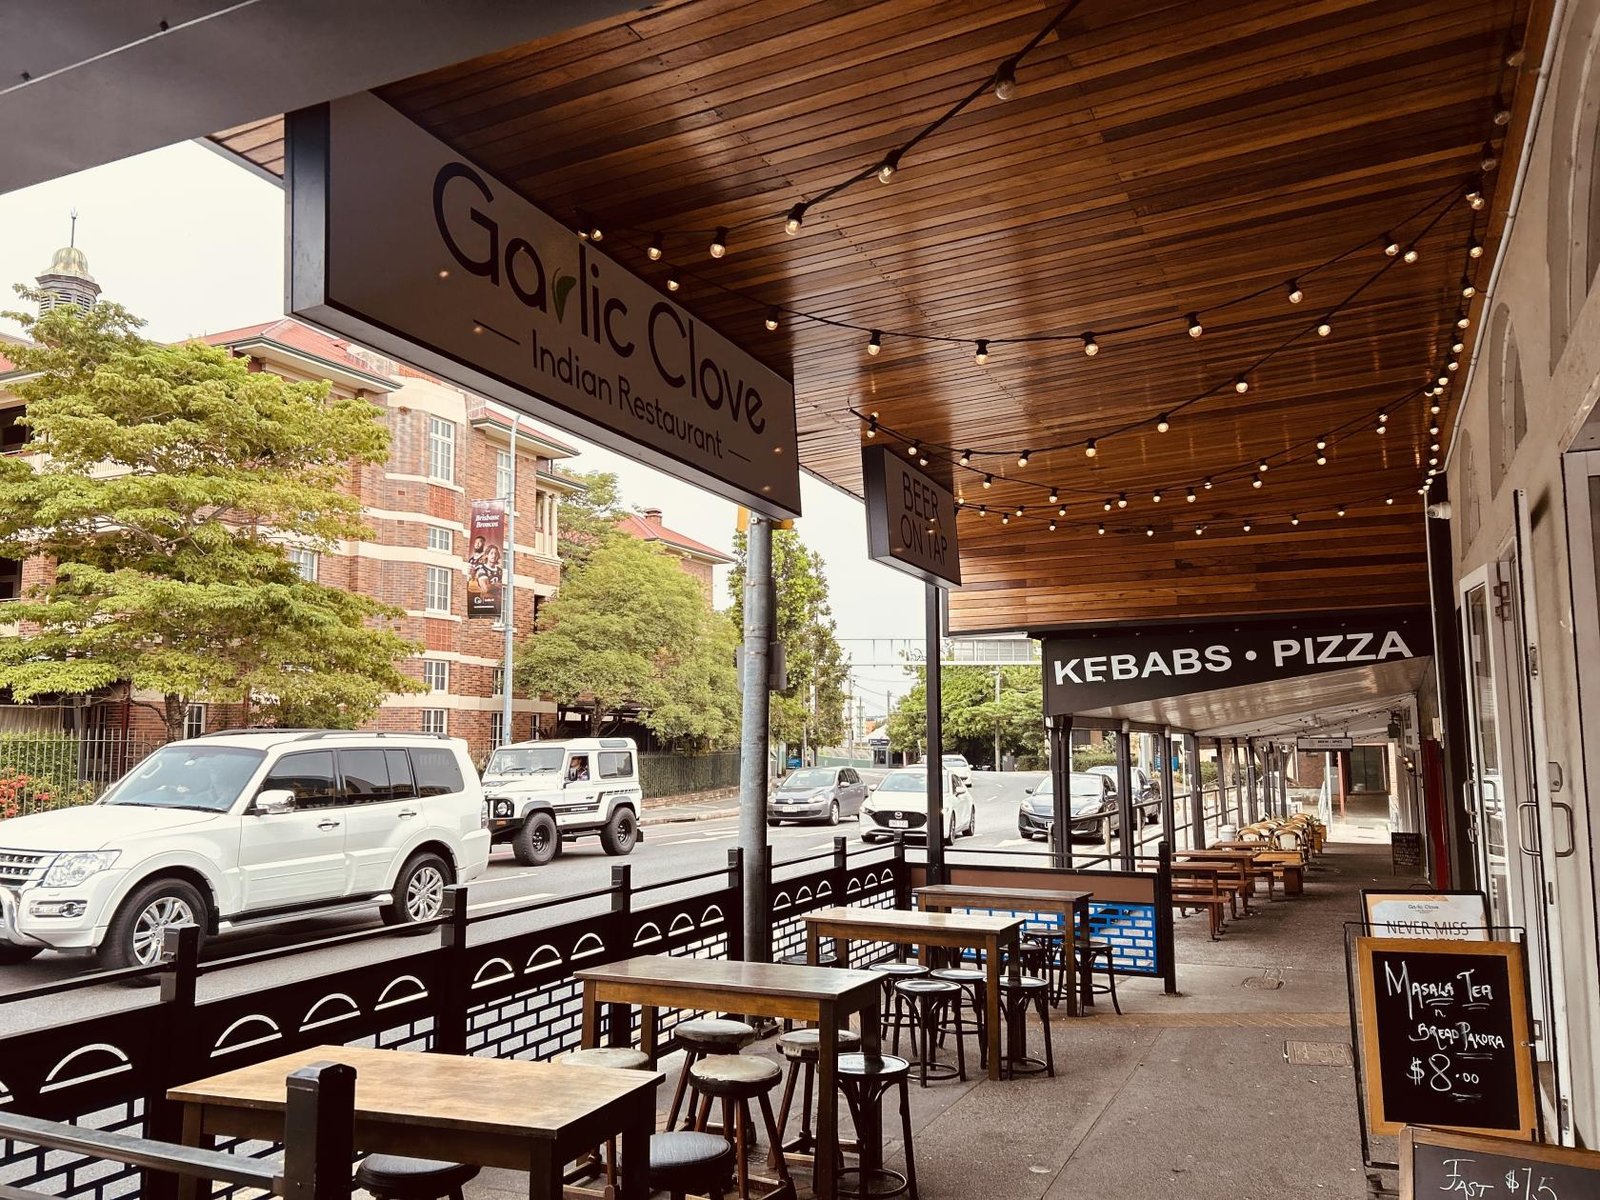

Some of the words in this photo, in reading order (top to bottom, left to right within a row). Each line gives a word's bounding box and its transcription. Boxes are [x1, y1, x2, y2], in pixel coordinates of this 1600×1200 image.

[431, 161, 636, 358] Garlic
[647, 301, 766, 436] Clove
[531, 328, 614, 407] Indian
[618, 375, 723, 460] Restaurant
[902, 470, 942, 529] BEER
[900, 513, 923, 555] ON
[925, 526, 948, 565] TAP
[1053, 644, 1232, 686] KEBABS
[1272, 630, 1414, 667] PIZZA
[1386, 920, 1431, 935] NEVER
[1434, 921, 1469, 938] MISS
